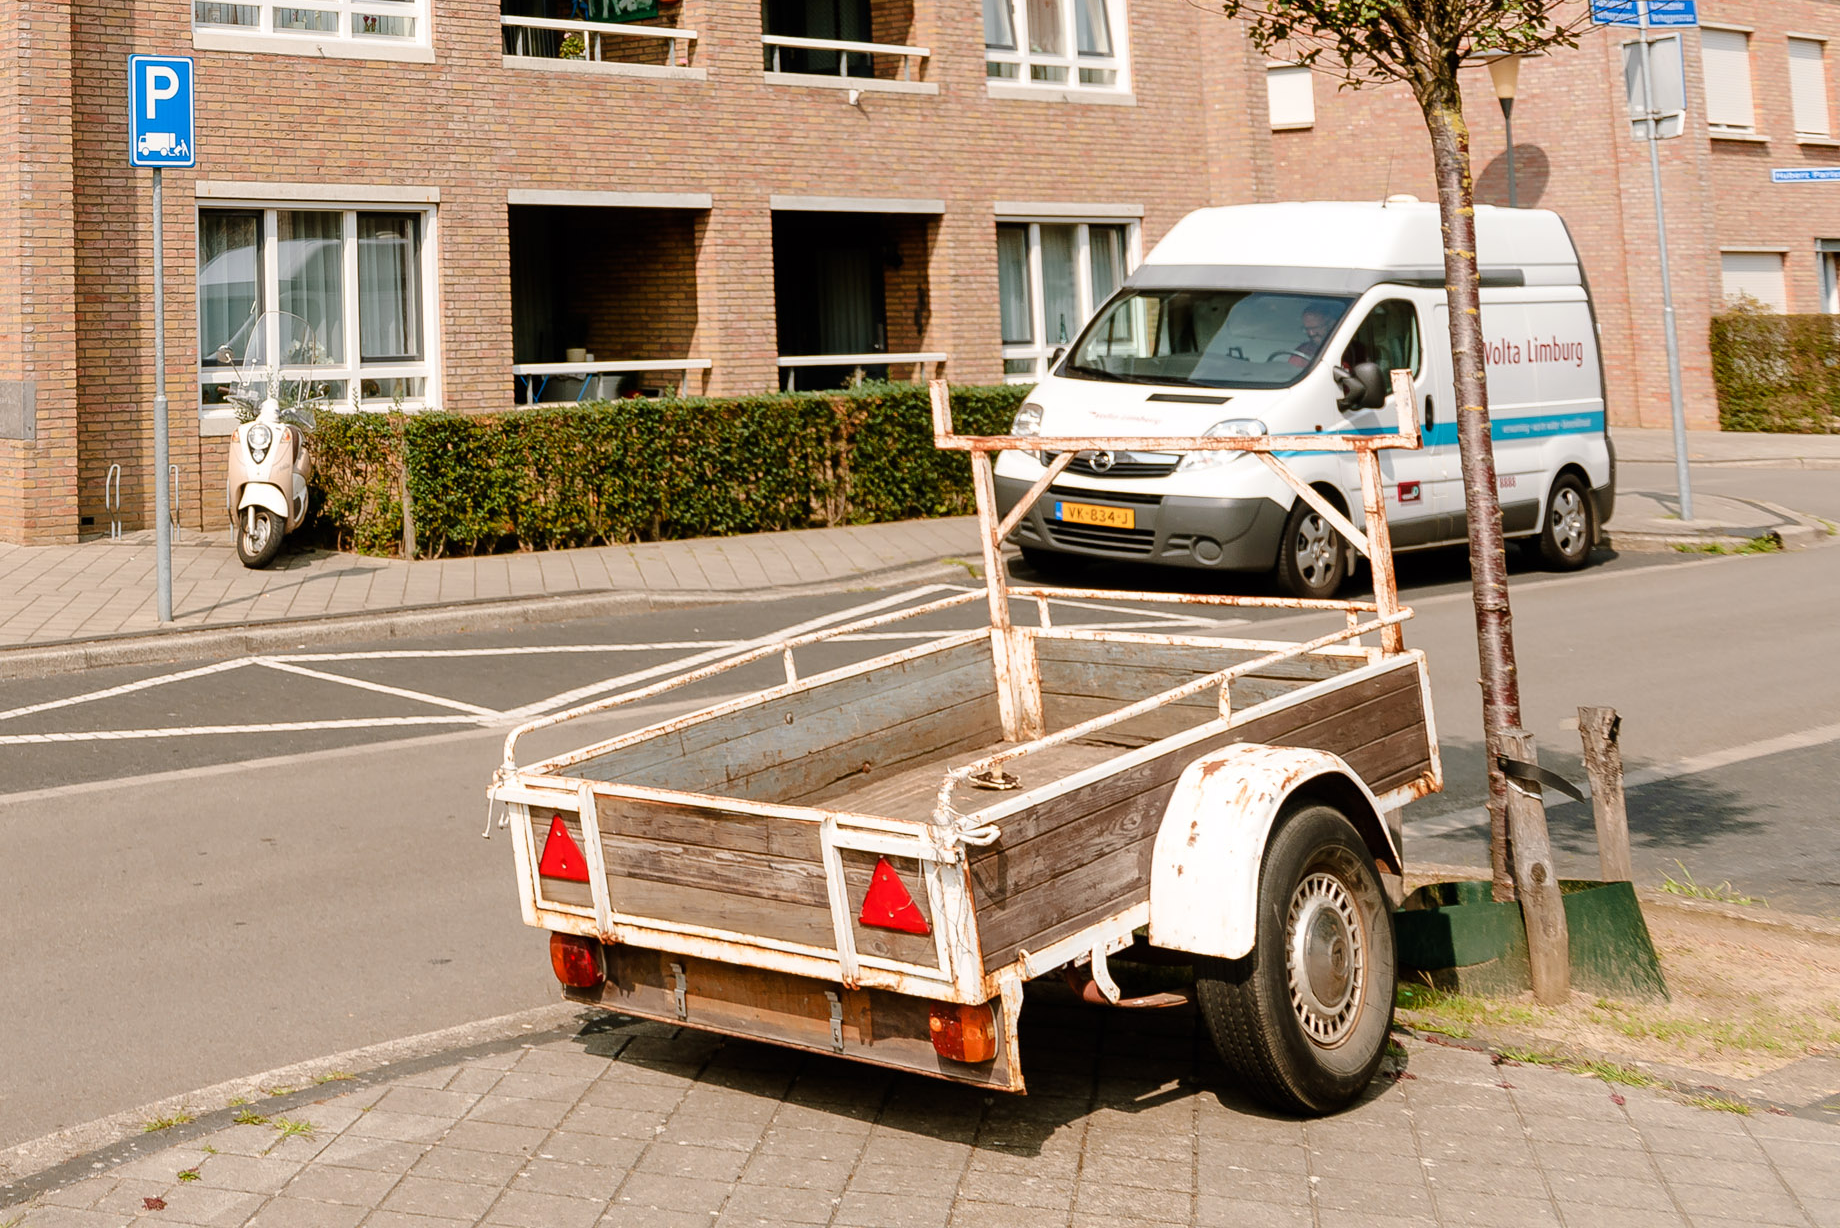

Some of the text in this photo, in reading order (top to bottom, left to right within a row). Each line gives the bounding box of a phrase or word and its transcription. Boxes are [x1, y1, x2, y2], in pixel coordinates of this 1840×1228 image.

[146, 65, 180, 119] P
[1483, 335, 1583, 367] Volta Limburg
[1068, 506, 1128, 525] VK-834-J
